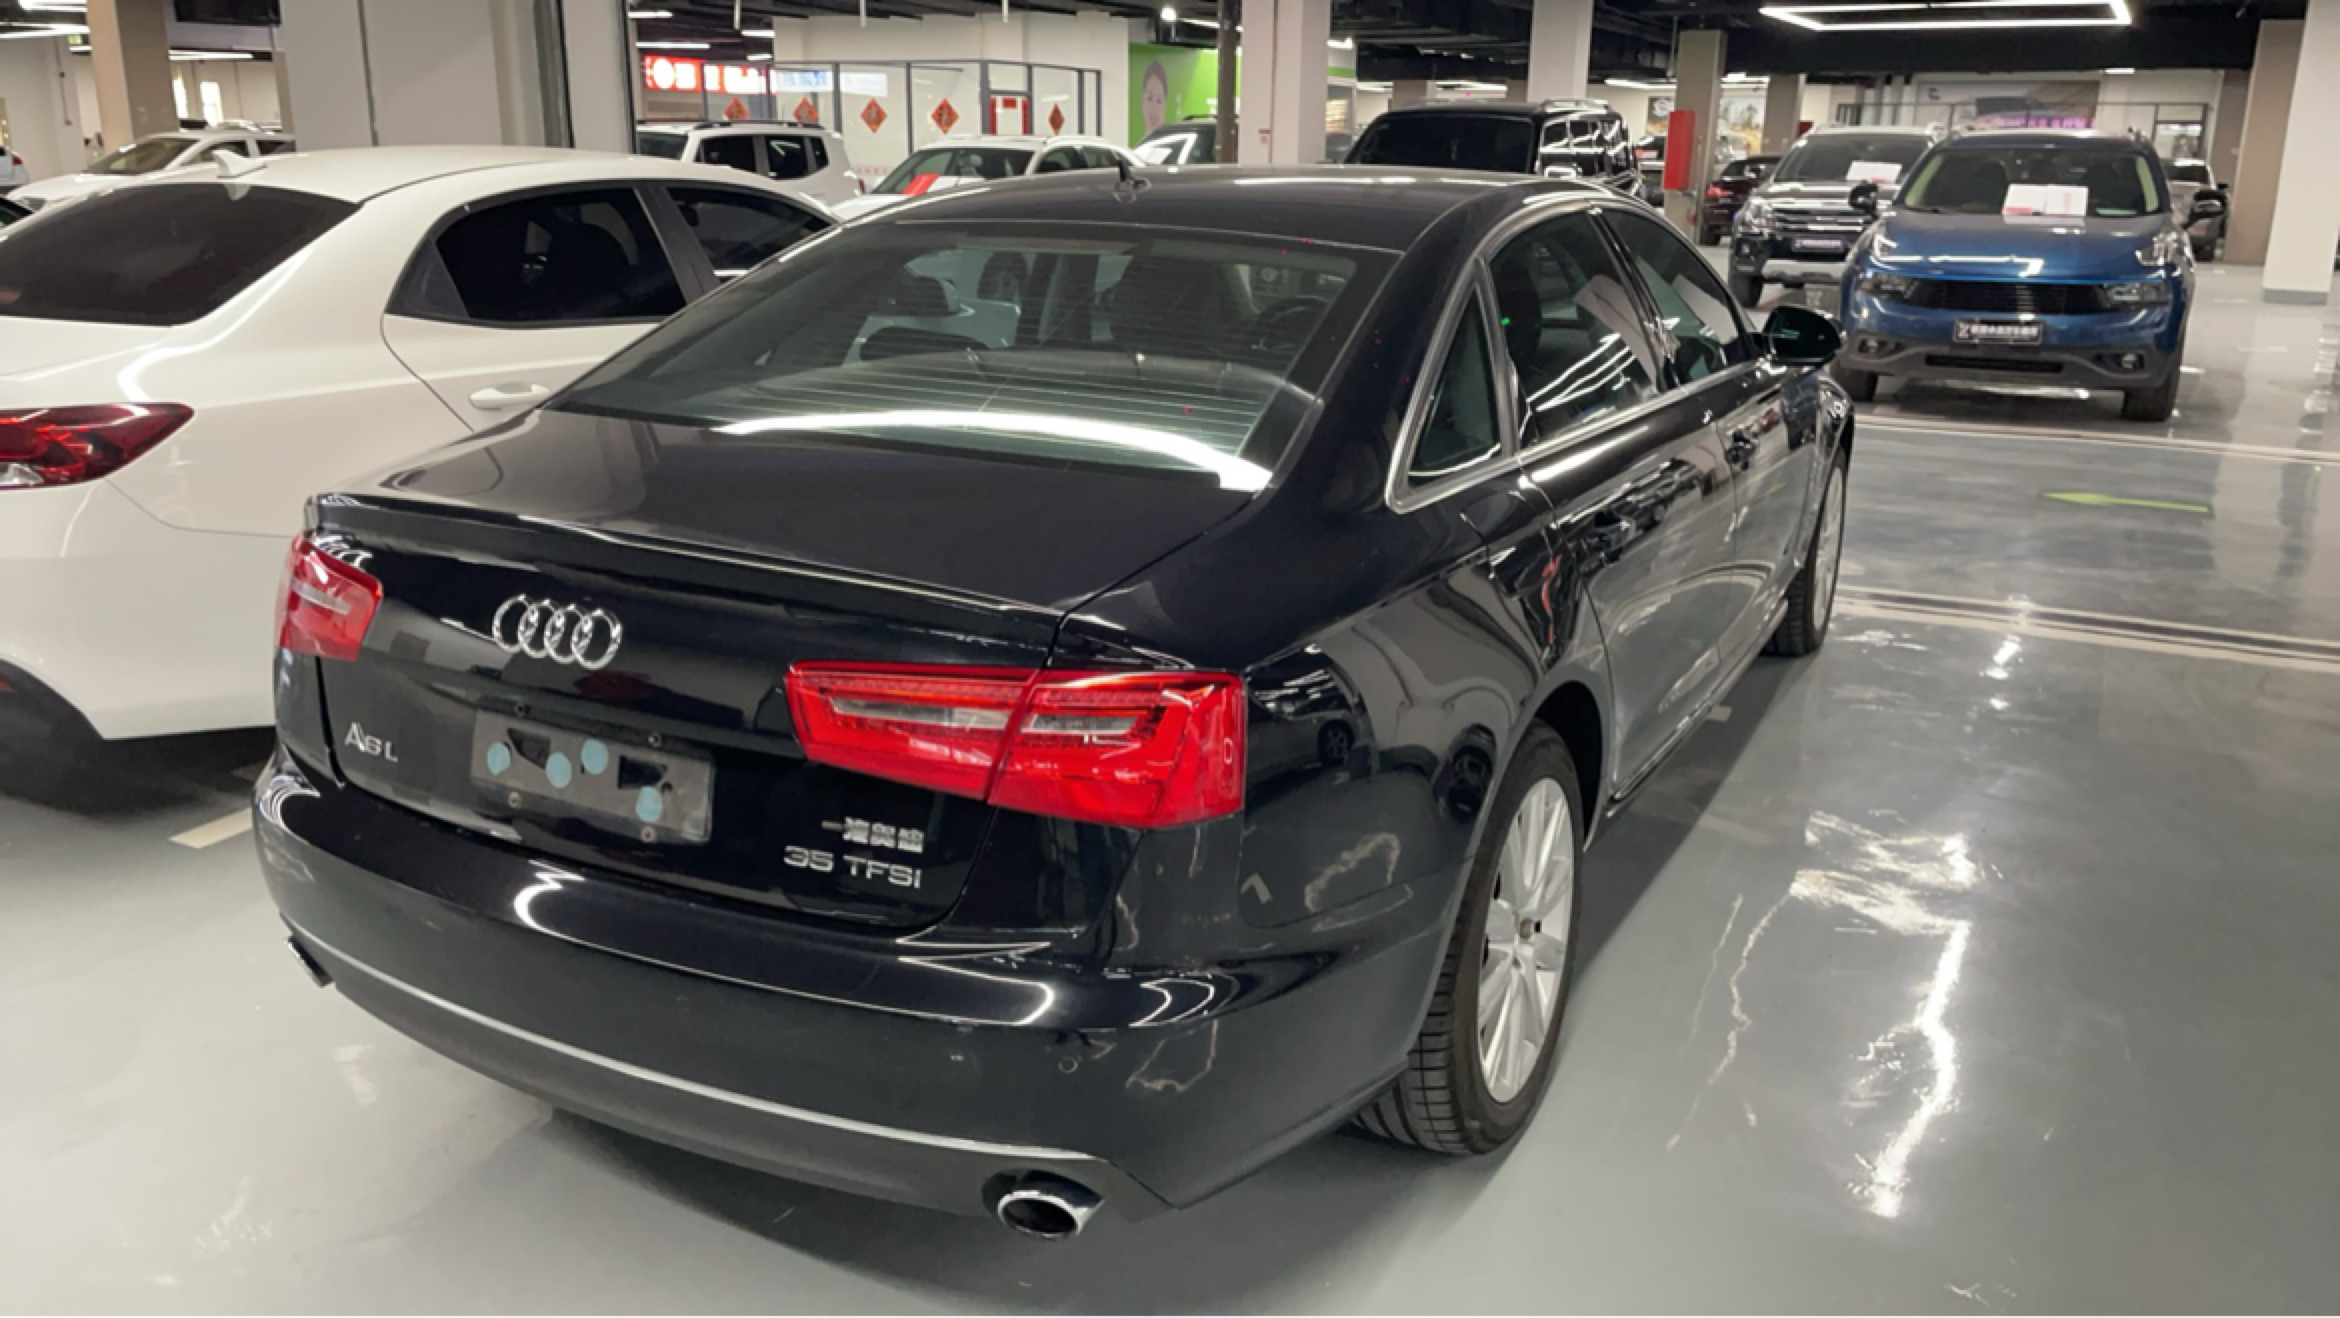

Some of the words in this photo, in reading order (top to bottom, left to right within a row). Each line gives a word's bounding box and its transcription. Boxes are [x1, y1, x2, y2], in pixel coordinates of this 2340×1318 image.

[344, 722, 399, 763] A6L
[784, 845, 835, 873] 35
[843, 853, 923, 889] TFSI
